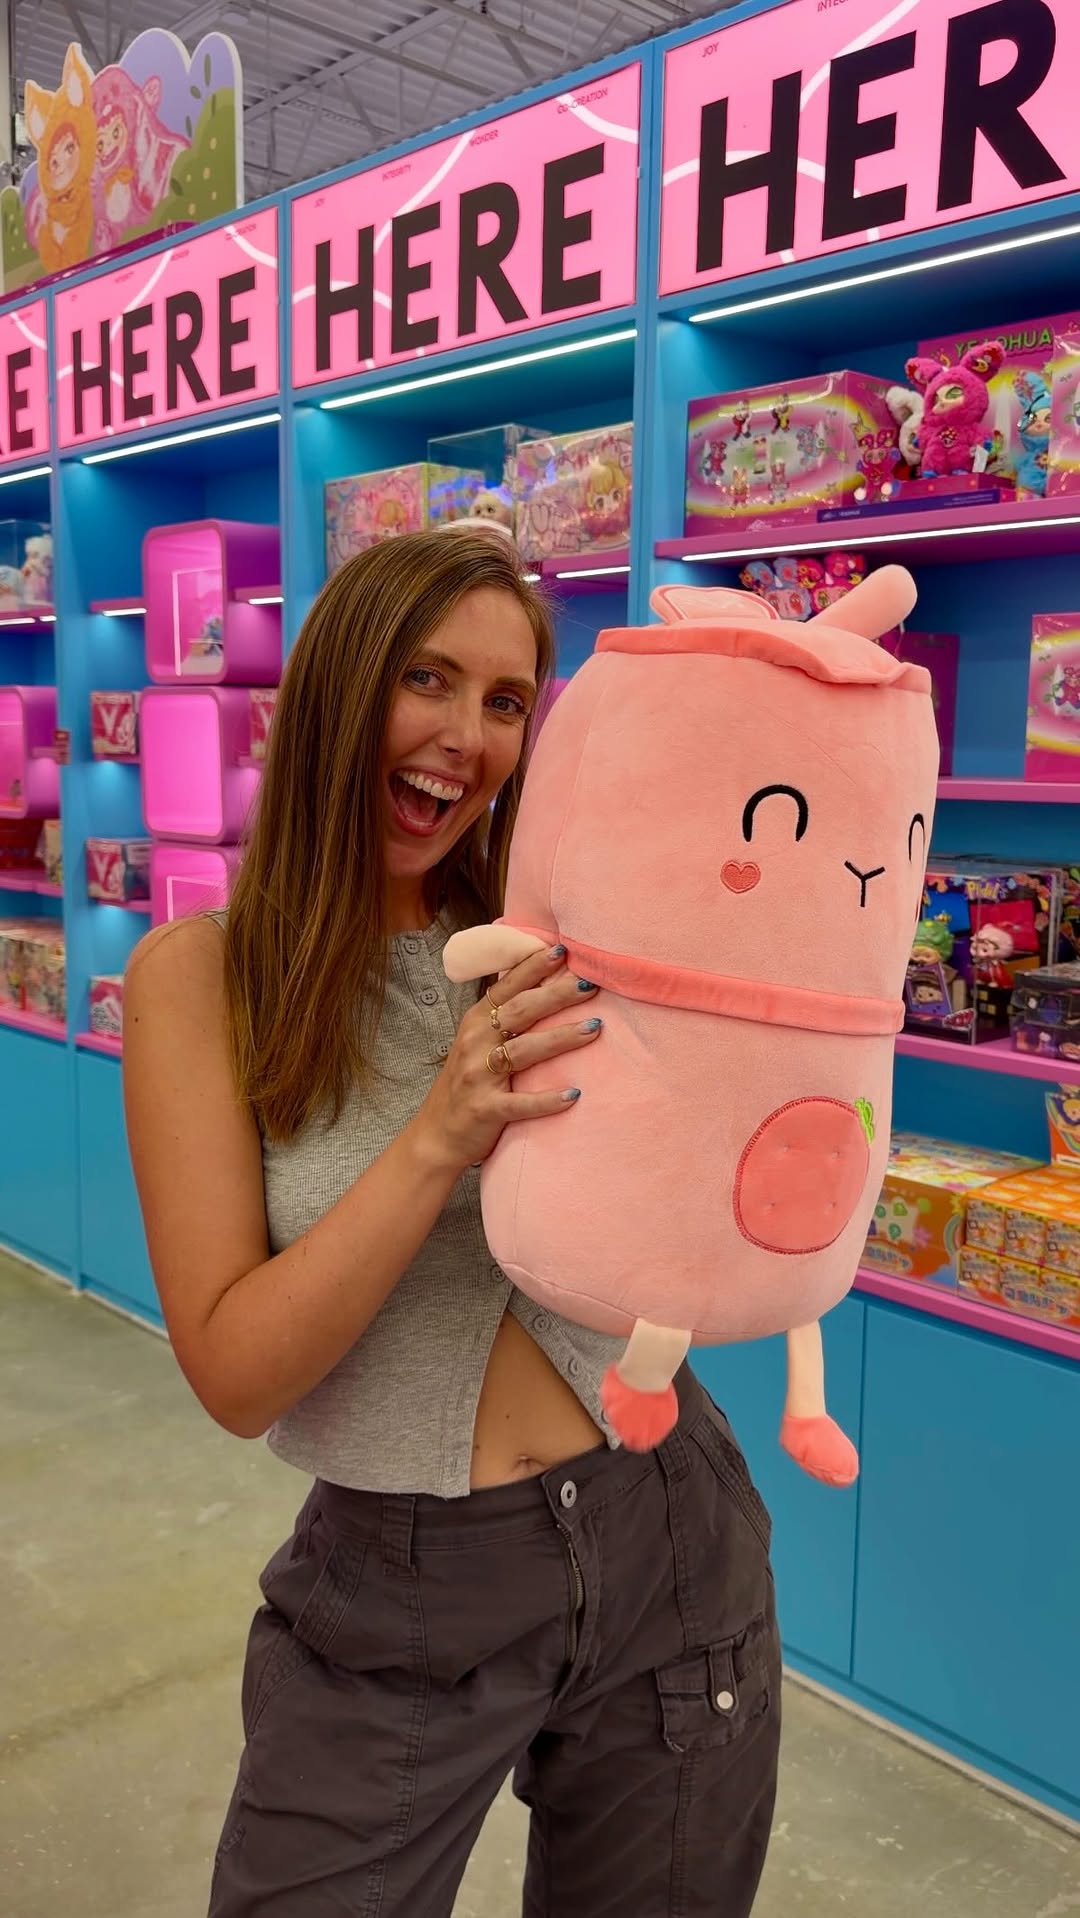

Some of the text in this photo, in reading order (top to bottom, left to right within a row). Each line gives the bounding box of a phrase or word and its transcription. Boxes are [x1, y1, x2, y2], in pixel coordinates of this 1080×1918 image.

[557, 87, 608, 114] CO-CREATION
[701, 42, 719, 58] JOY
[469, 129, 498, 146] WONDER
[696, 0, 1068, 273] HER
[315, 142, 605, 372] HERE
[0, 347, 33, 454] E
[72, 266, 256, 435] HERE
